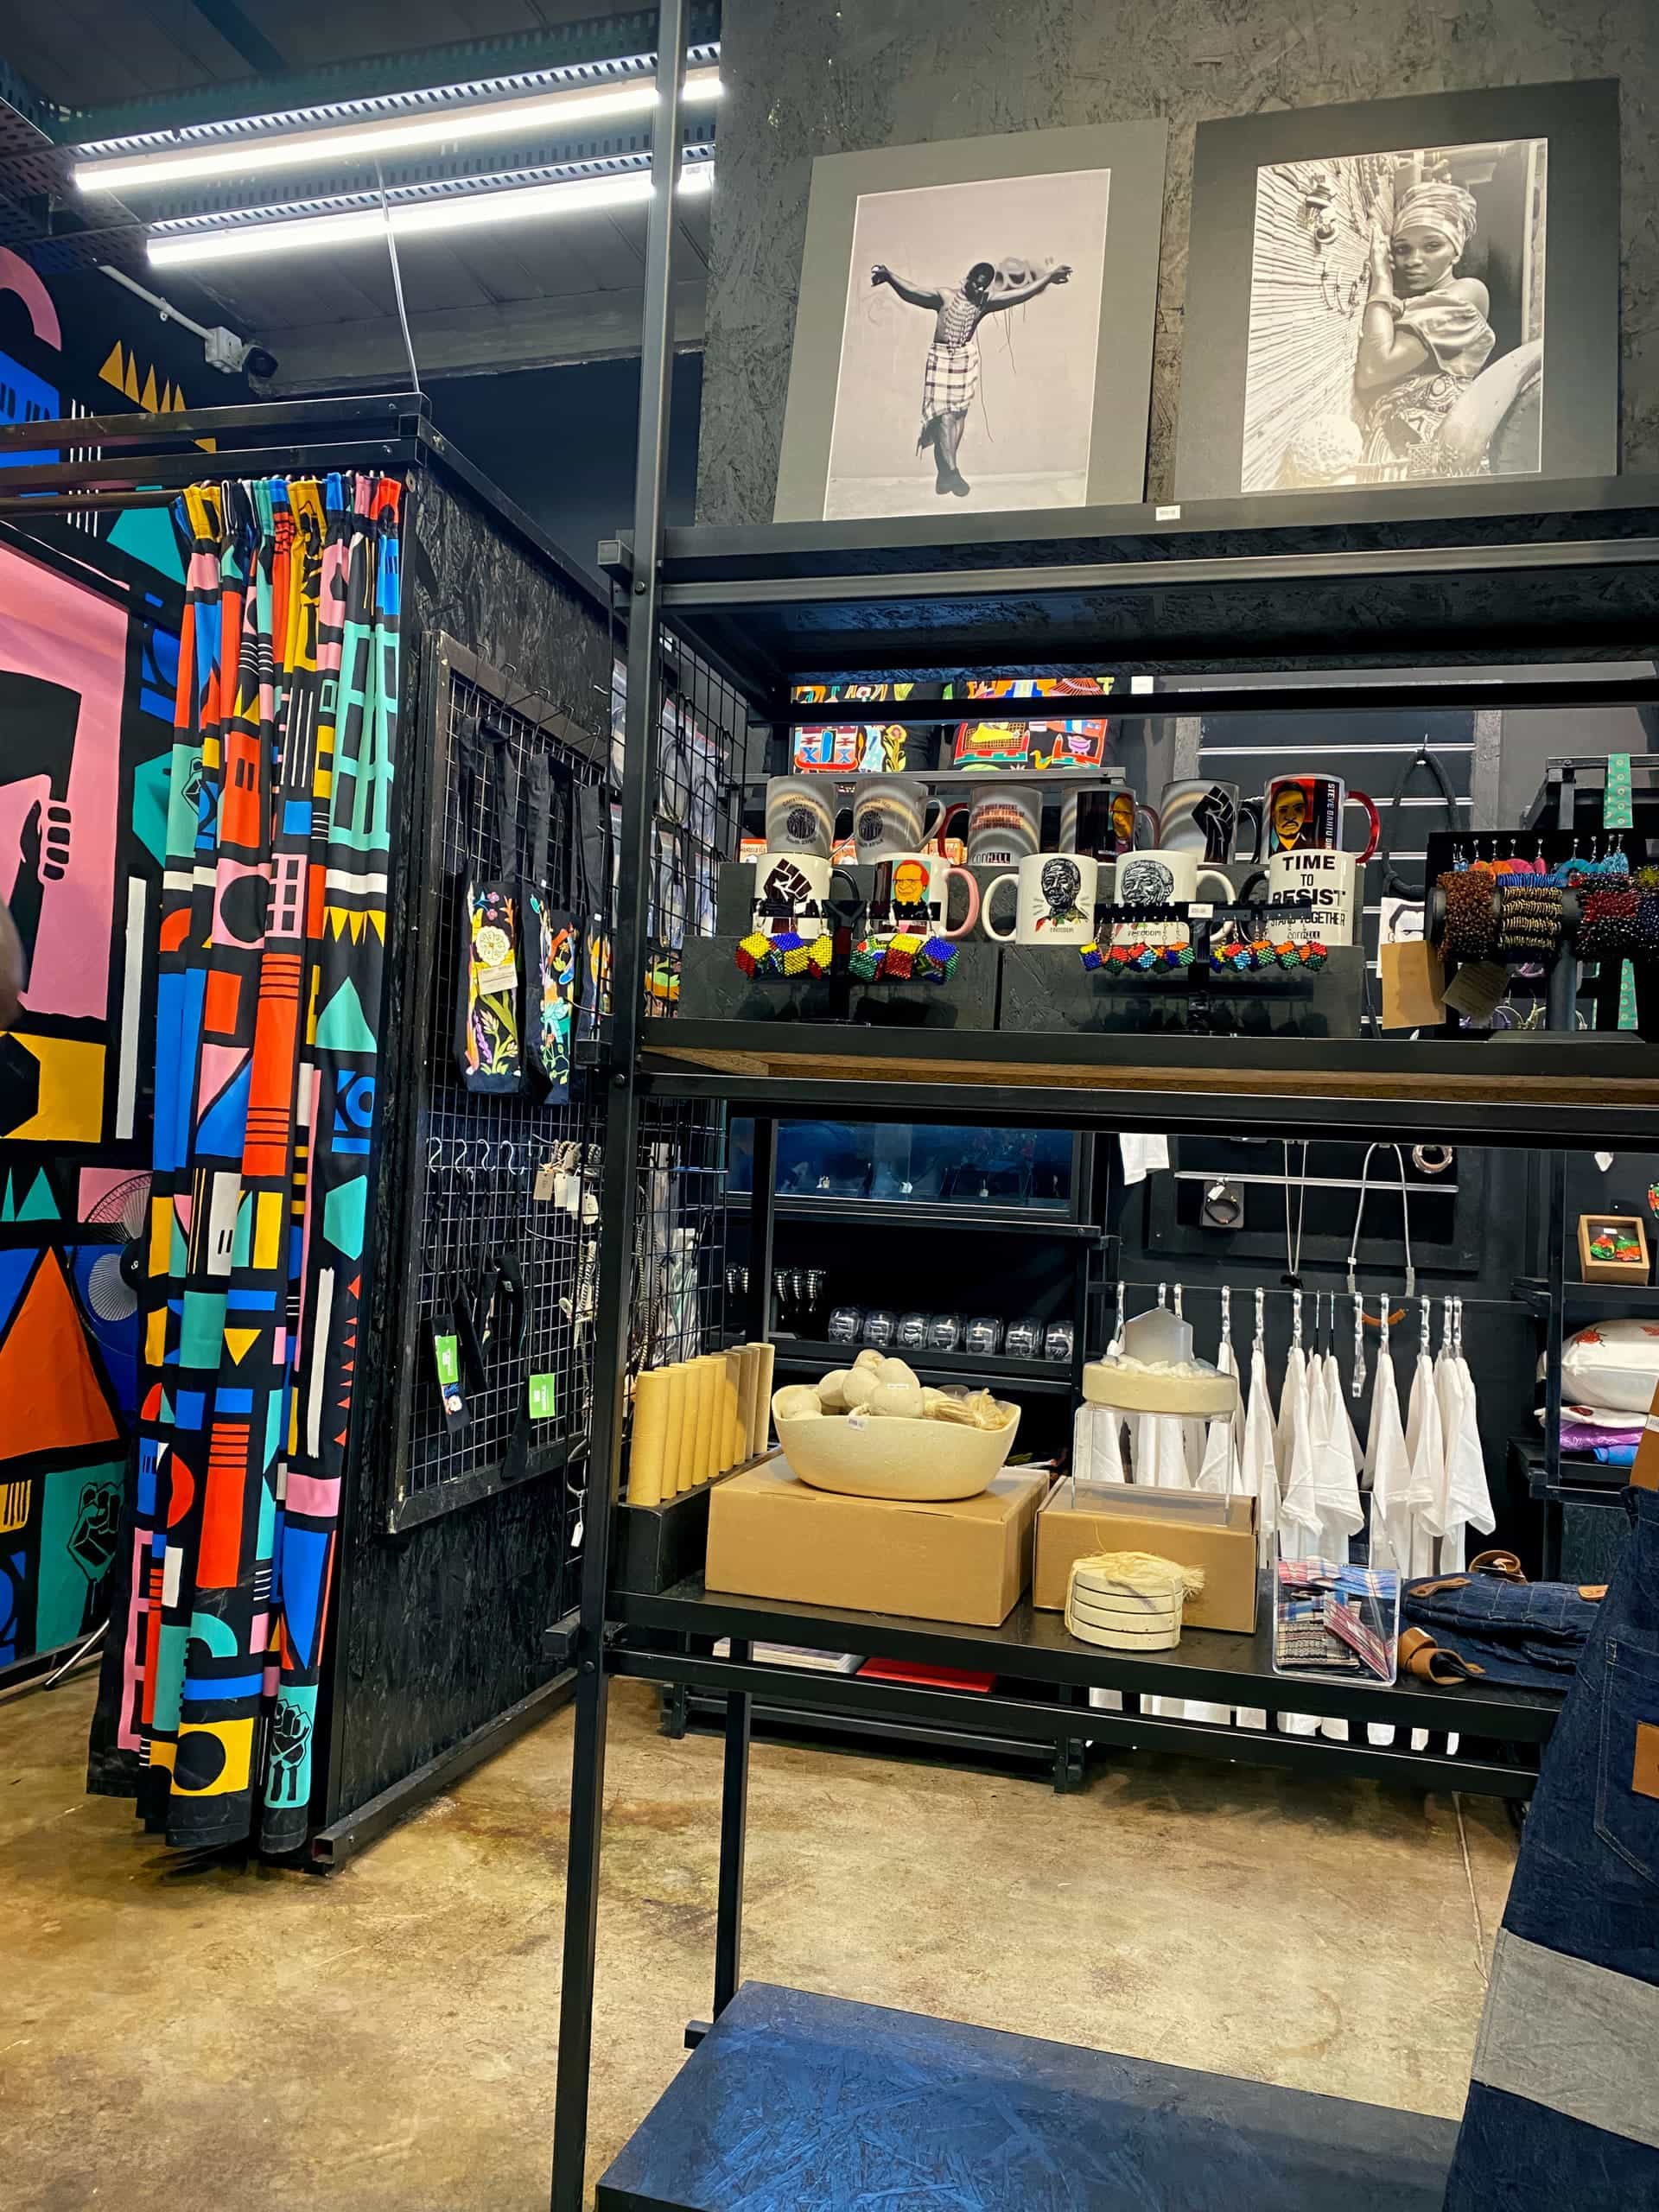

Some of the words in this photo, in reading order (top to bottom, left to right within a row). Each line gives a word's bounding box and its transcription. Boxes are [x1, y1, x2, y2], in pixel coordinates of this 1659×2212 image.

[1327, 783, 1336, 809] STEVE
[1282, 855, 1335, 871] TIME
[1300, 874, 1313, 887] TO
[1273, 888, 1345, 906] RESIST
